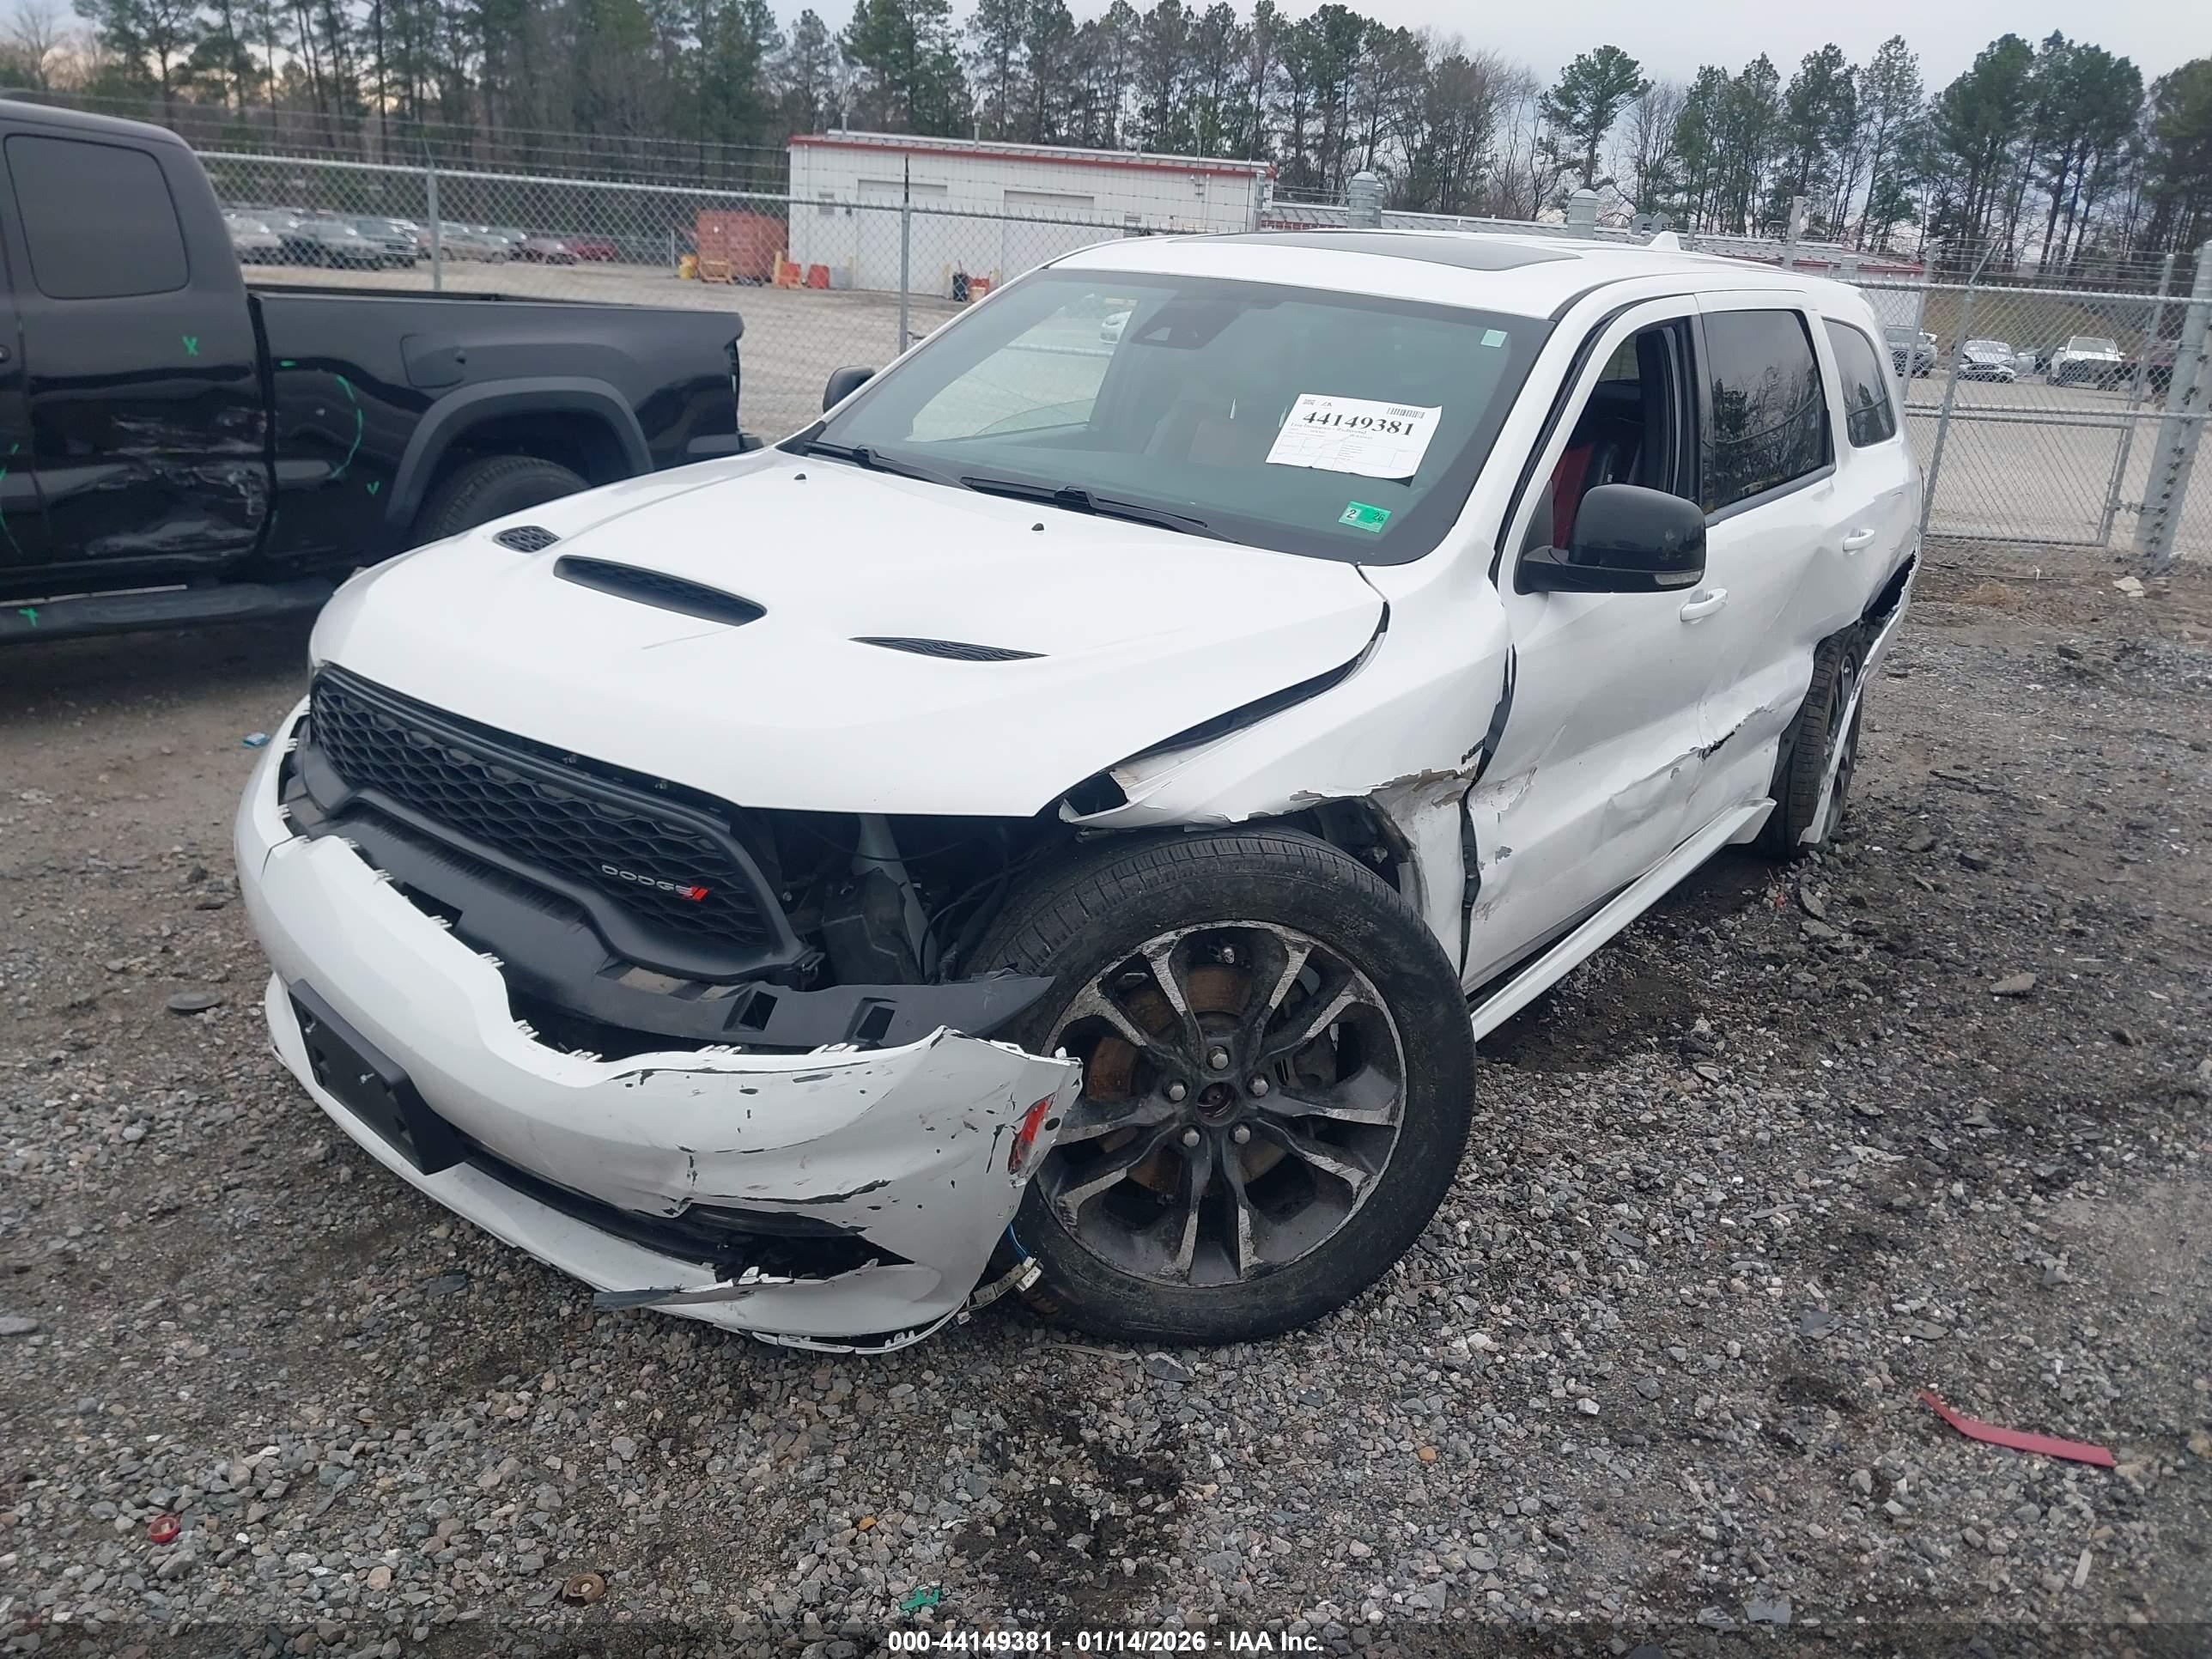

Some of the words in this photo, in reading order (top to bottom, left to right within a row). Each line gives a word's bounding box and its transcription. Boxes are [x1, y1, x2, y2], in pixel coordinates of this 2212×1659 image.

[1303, 411, 1414, 436] 44149381
[1346, 508, 1357, 520] 2
[1372, 512, 1386, 522] 26
[601, 864, 693, 897] DODGE
